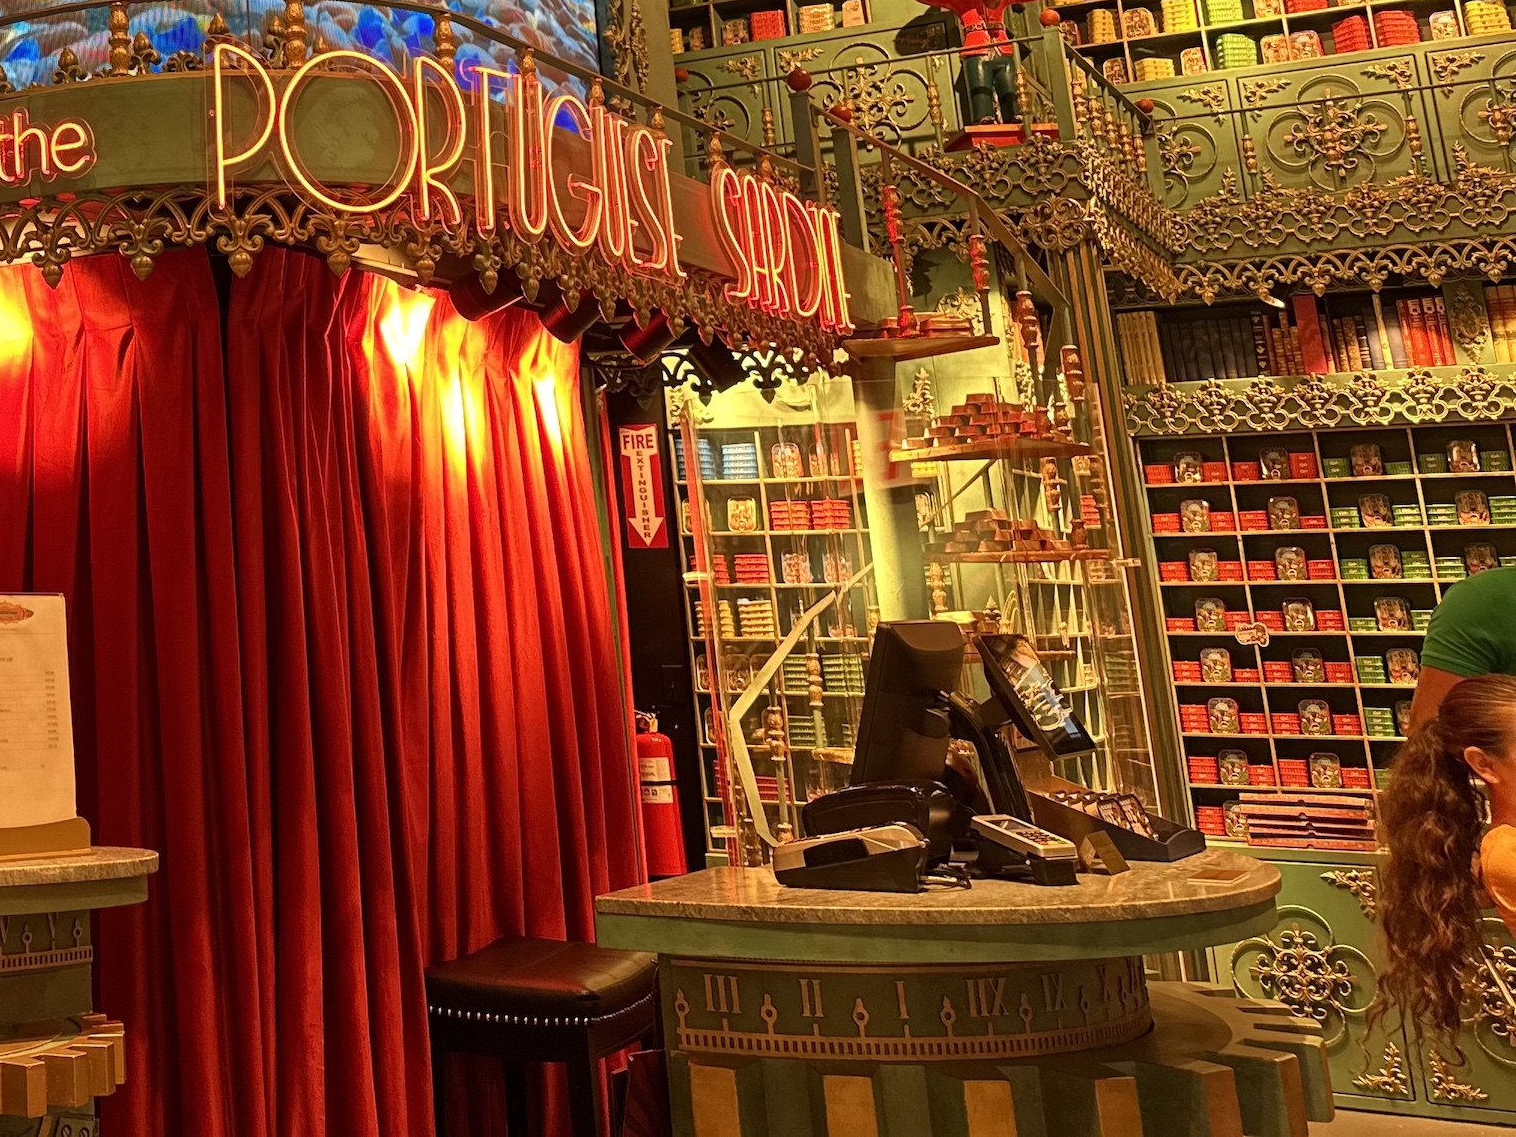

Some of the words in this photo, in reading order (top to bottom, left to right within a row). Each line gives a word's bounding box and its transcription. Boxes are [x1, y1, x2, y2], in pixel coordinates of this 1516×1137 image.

[212, 40, 688, 279] PORTUGUESE
[714, 165, 857, 337] SARDINE
[622, 433, 654, 450] FIRE
[635, 449, 652, 539] EXTINGUISHER
